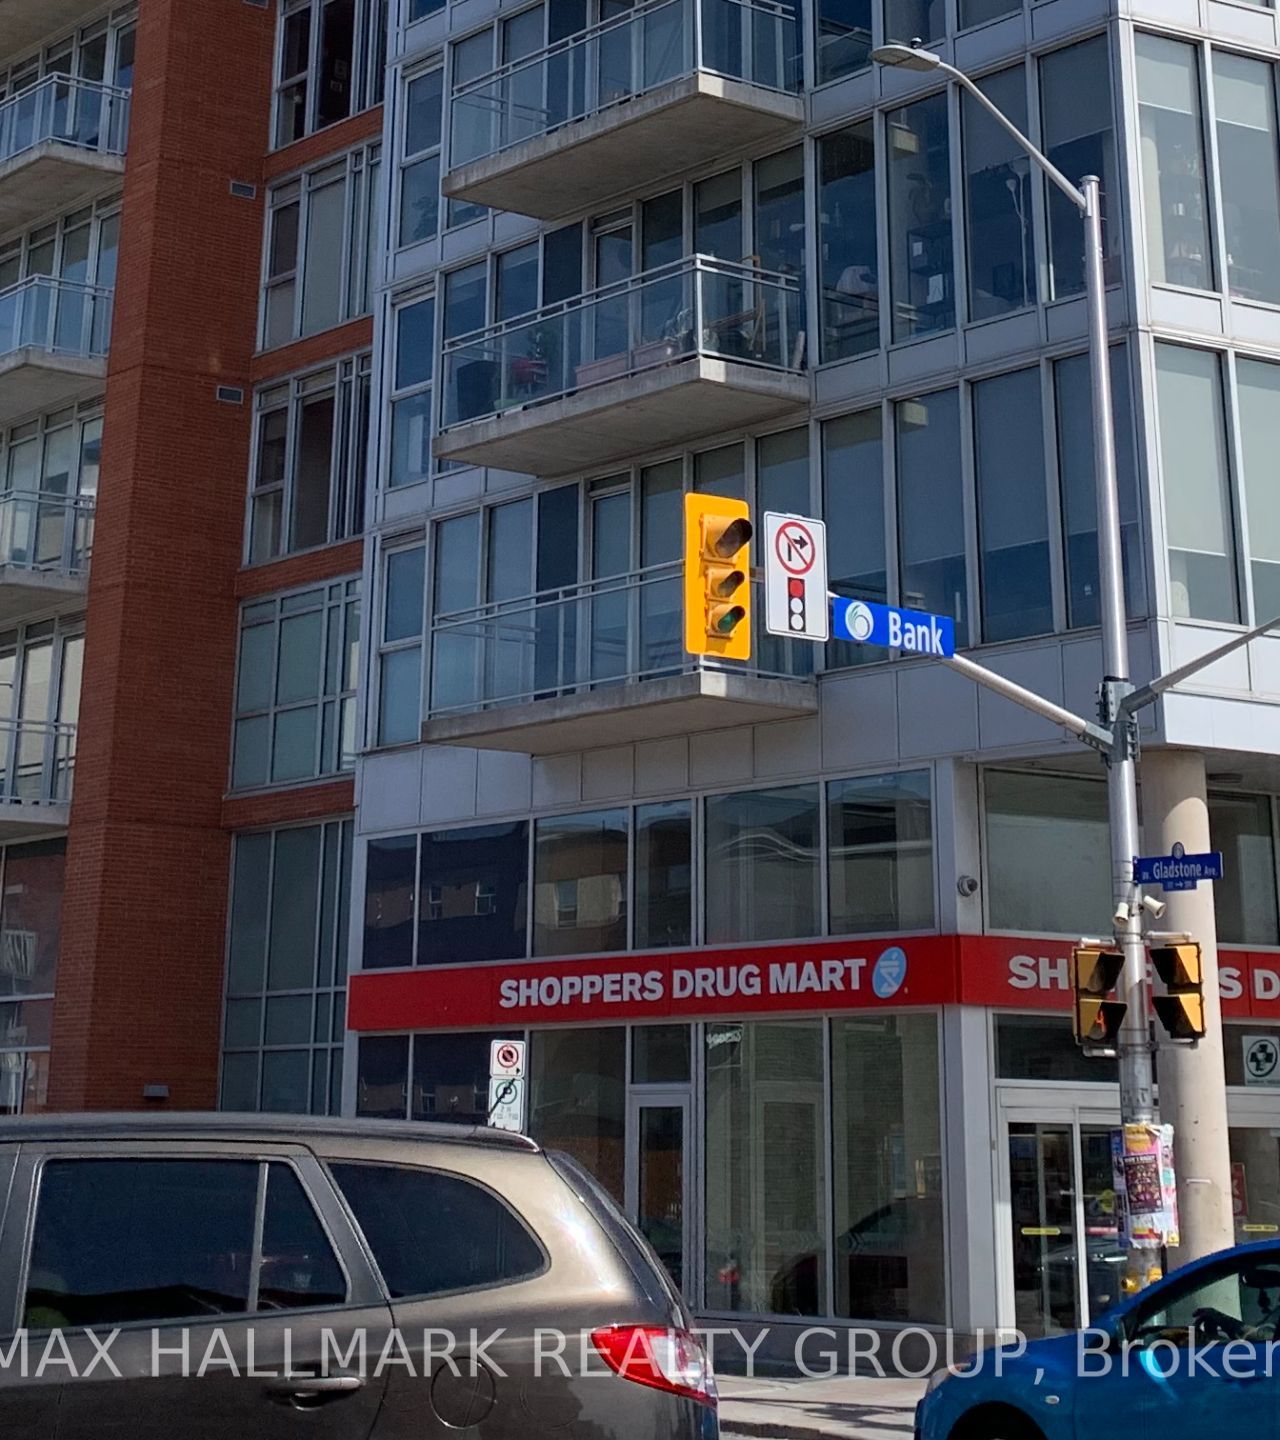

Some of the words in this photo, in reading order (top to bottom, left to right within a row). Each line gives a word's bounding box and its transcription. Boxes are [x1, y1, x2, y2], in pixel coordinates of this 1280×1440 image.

[888, 610, 945, 656] Bank
[1153, 860, 1202, 879] Gladstone
[499, 970, 663, 1009] SHOPPERS
[672, 964, 761, 999] DRUG
[769, 958, 867, 994] MART
